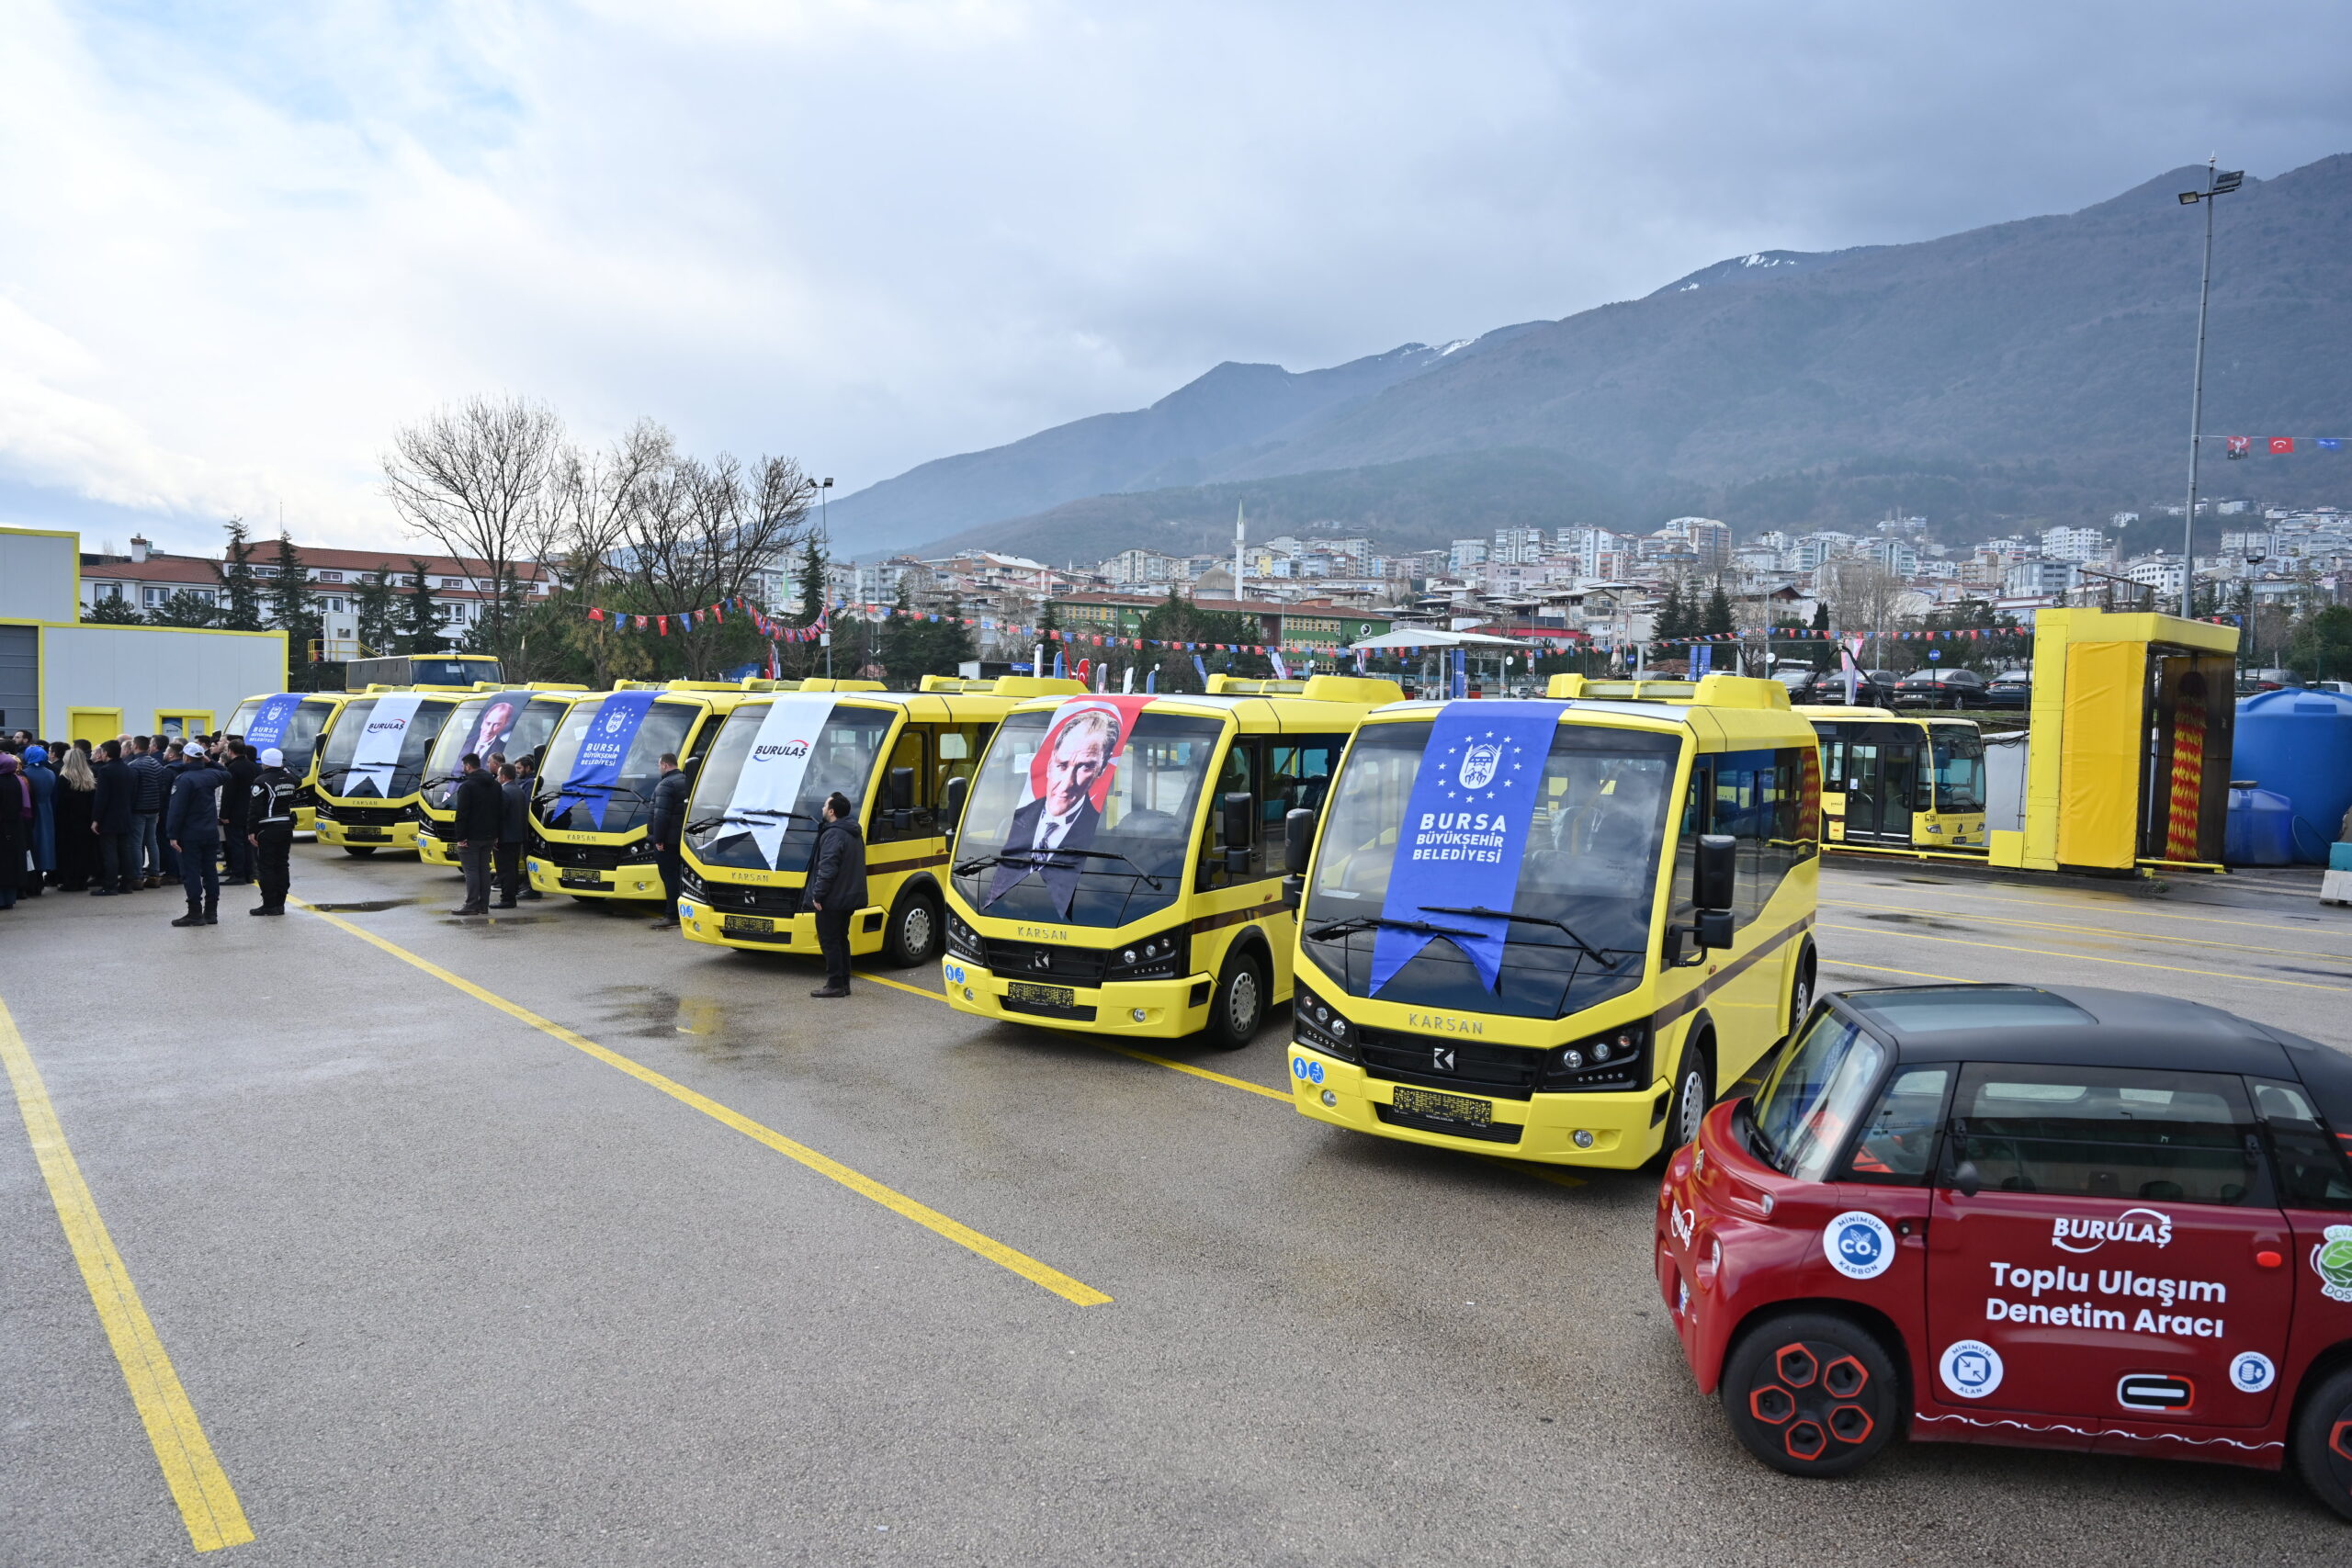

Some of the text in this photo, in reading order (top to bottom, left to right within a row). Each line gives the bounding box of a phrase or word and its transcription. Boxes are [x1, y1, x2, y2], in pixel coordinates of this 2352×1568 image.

[368, 723, 404, 731] BURULAŞ
[586, 742, 620, 752] BURSA
[754, 745, 808, 759] BURULAŞ
[581, 758, 616, 767] BELEDİYESİ
[582, 751, 618, 760] BÜYÜKŞEHİR
[1419, 813, 1506, 833] BURSA
[567, 834, 596, 842] KARSAN
[1416, 830, 1504, 847] BÜYÜKŞEHİR
[1412, 844, 1502, 863] BELEDİYESİ
[731, 872, 769, 882] KARSAN
[1018, 926, 1067, 941] KARSAN
[1409, 1013, 1483, 1034] KARSAN
[1838, 1215, 1883, 1231] MİNİMUM
[2052, 1217, 2172, 1249] BURULAŞ
[1838, 1260, 1878, 1274] KARBON
[1990, 1262, 2226, 1307] Toplu Ulaşım
[1986, 1298, 2223, 1337] Denetim Aracı
[1952, 1343, 1992, 1358] MİNİMUM
[1959, 1386, 1983, 1394] ALAN
